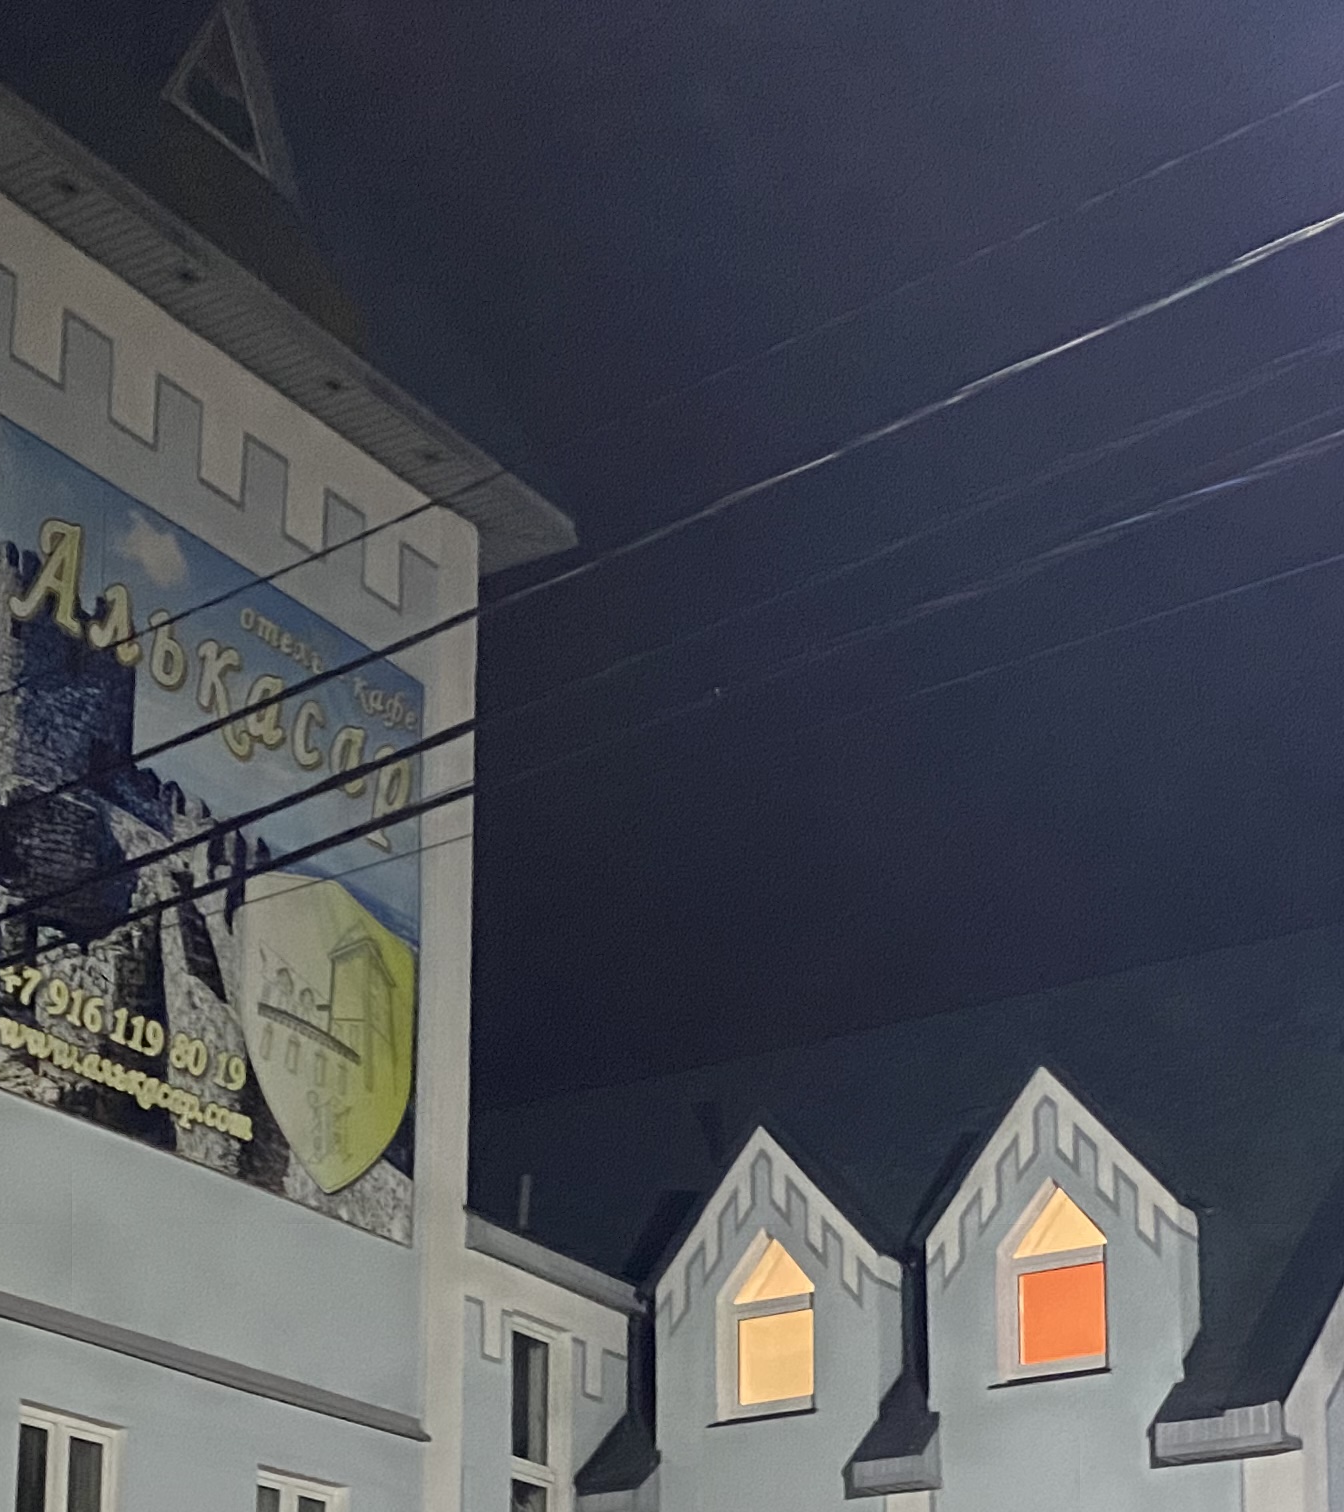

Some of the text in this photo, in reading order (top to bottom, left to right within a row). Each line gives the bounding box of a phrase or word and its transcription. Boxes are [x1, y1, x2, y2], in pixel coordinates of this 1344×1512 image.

[8, 517, 414, 853] Алькасар
[47, 978, 105, 1034] 916
[109, 1007, 165, 1057] 119
[170, 1033, 208, 1077] 80
[212, 1051, 248, 1092] 19
